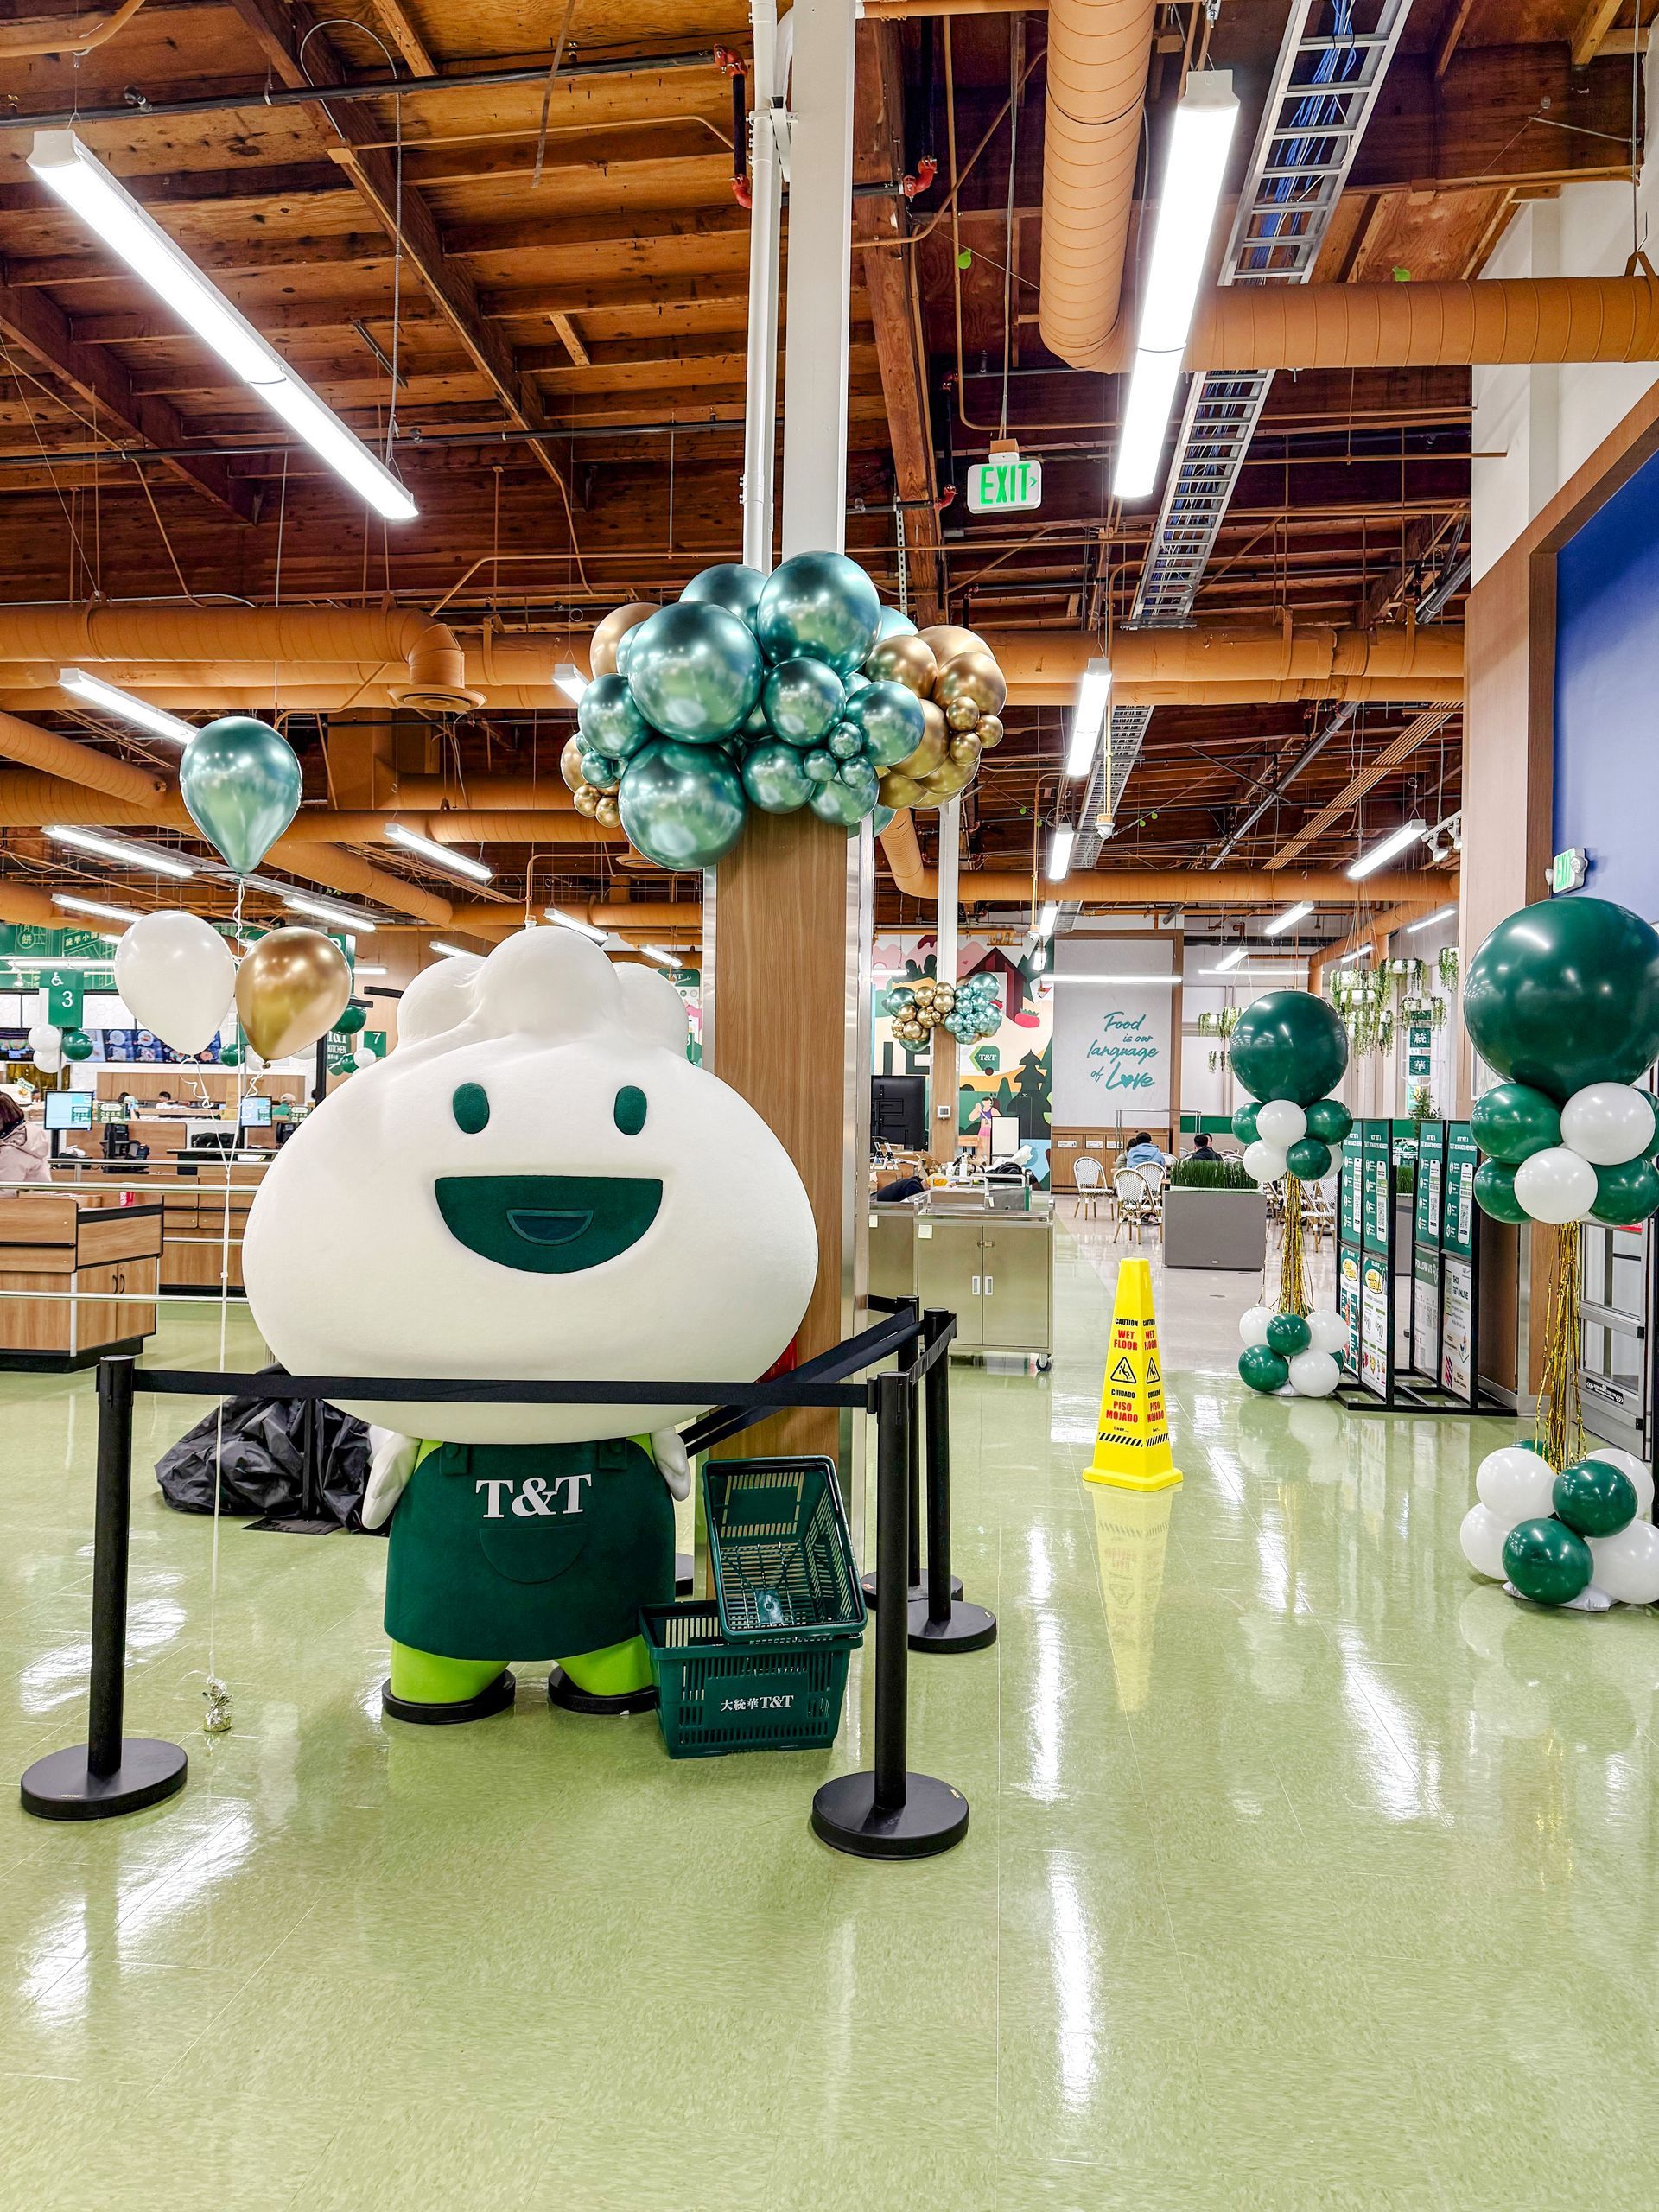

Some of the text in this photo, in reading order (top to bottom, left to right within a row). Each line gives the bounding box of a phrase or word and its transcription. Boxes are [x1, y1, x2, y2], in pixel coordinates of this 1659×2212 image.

[980, 463, 1031, 505] EXIT
[61, 990, 73, 1007] 3
[1103, 1011, 1147, 1032] Food
[372, 1032, 381, 1044] 7
[1122, 1033, 1133, 1043] is
[1086, 1039, 1160, 1065] language
[1090, 1066, 1104, 1083] of
[1115, 1318, 1139, 1327] CAUTION
[1142, 1319, 1155, 1327] CAUTION
[1118, 1329, 1135, 1339] WET
[1145, 1330, 1154, 1339] WET
[1113, 1339, 1138, 1351] FLOOR
[1144, 1339, 1157, 1351] FLOOR
[1111, 1389, 1135, 1399] CUIDADO
[1147, 1389, 1160, 1399] CUIDADO
[1113, 1400, 1132, 1412] PISO
[1149, 1401, 1160, 1412] PISO
[1105, 1409, 1138, 1423] MOJADO
[1147, 1409, 1164, 1423] MOJADO
[475, 1473, 592, 1518] T&T
[720, 1694, 794, 1712] 大統華 T&T
